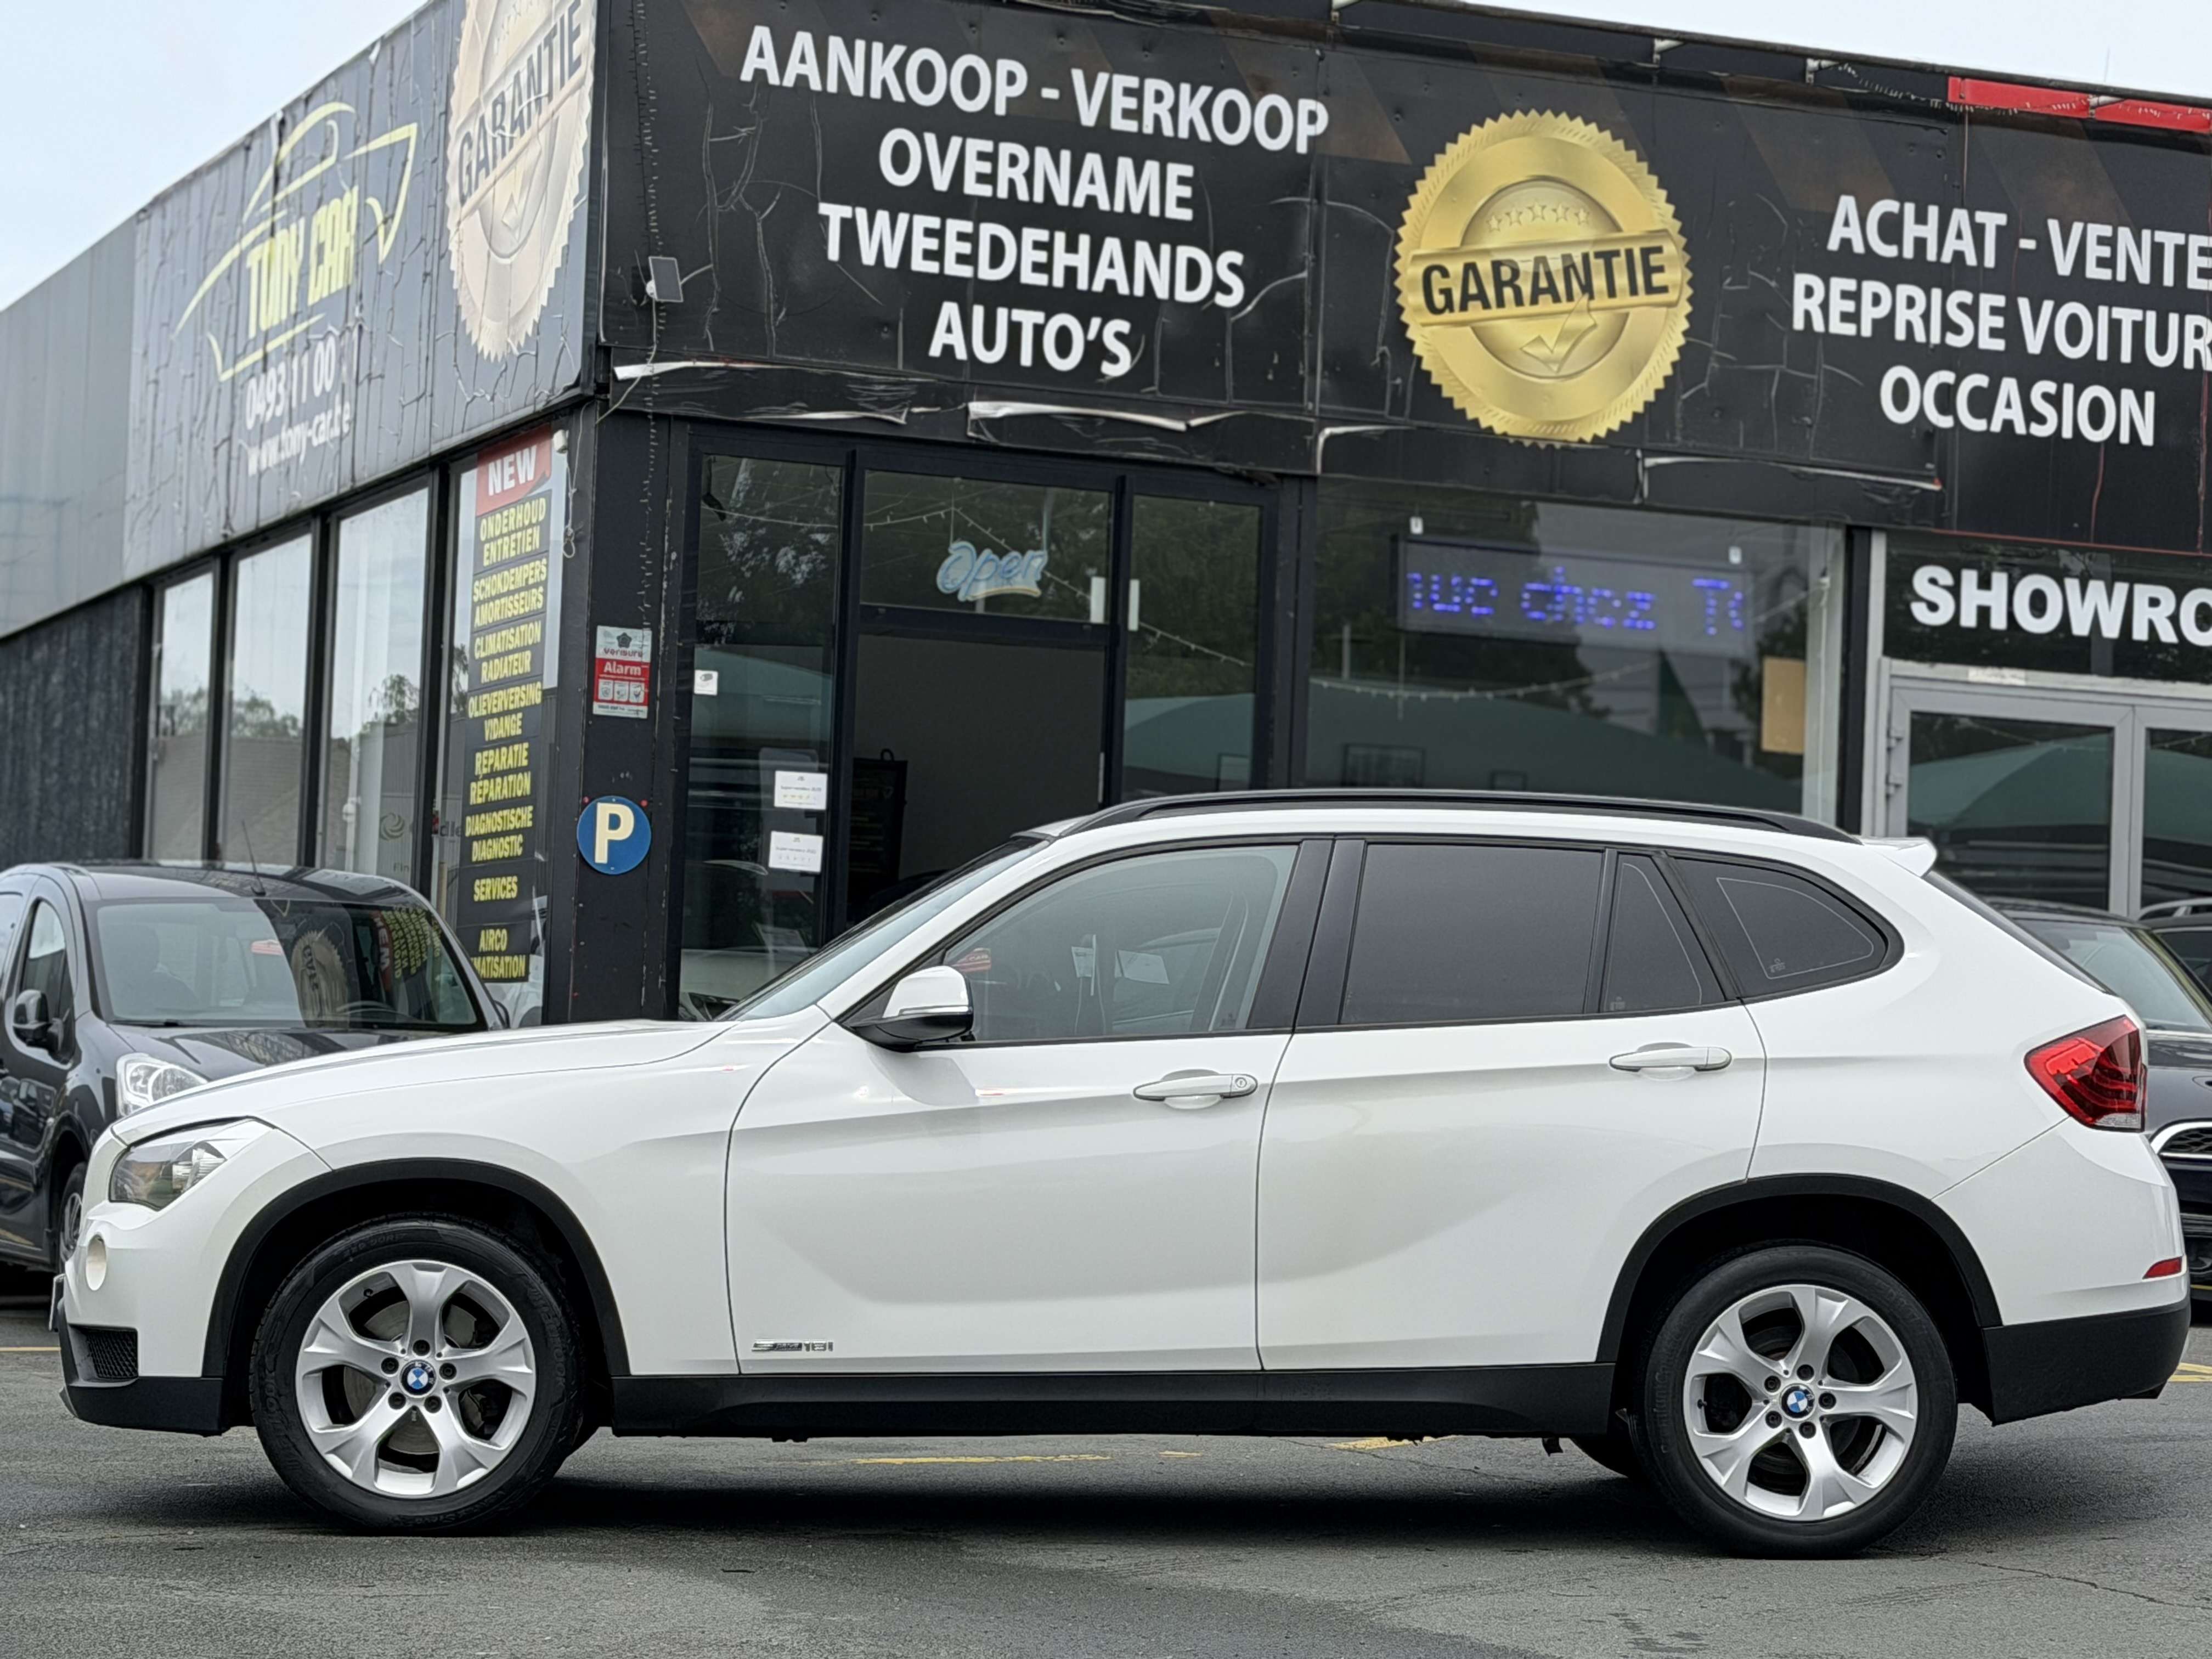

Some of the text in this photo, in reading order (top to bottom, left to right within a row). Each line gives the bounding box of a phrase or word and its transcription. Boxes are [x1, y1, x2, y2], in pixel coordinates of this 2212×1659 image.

[459, 0, 582, 207] GARANTIE
[740, 25, 1028, 116] AANKOOP
[1071, 67, 1329, 154] VERKOOP
[879, 128, 1194, 221] OVERNAME
[246, 184, 359, 340] TONY CAR
[817, 202, 1245, 308] TWEEDEHANDS
[1827, 195, 2007, 268] ACHAT
[2047, 218, 2212, 291] VENTE
[1422, 245, 1669, 315] GARANTIE
[928, 301, 1132, 377] AUTO'S
[1792, 273, 2212, 372] REPRISE VOITUR
[246, 361, 285, 430] 0493
[313, 335, 336, 398] 00
[1880, 365, 2155, 446] OCCASION
[488, 445, 538, 496] NEW
[480, 498, 546, 541] ONDERHOUD
[483, 525, 540, 567] ENTRETIEN
[473, 558, 547, 602] SCHOKDEMPERS
[936, 541, 1048, 601] Open
[474, 586, 544, 628] AMORTISSEURS
[1910, 565, 2212, 646] SHOWRO
[475, 620, 541, 659] CLIMATISATION
[481, 650, 531, 684] RADIATEUR
[603, 661, 641, 676] Alarm
[469, 681, 542, 719] OLIEVERVERSING
[484, 713, 522, 741] VIDANGE
[475, 742, 529, 776] REPARATIE
[465, 805, 533, 837] DIAGNOSTISCHE
[595, 803, 634, 864] P
[472, 834, 523, 862] DIAGNOSTIC
[473, 876, 518, 901] SERVICES
[478, 928, 507, 952] AIRCO
[471, 955, 526, 978] MATISATION
